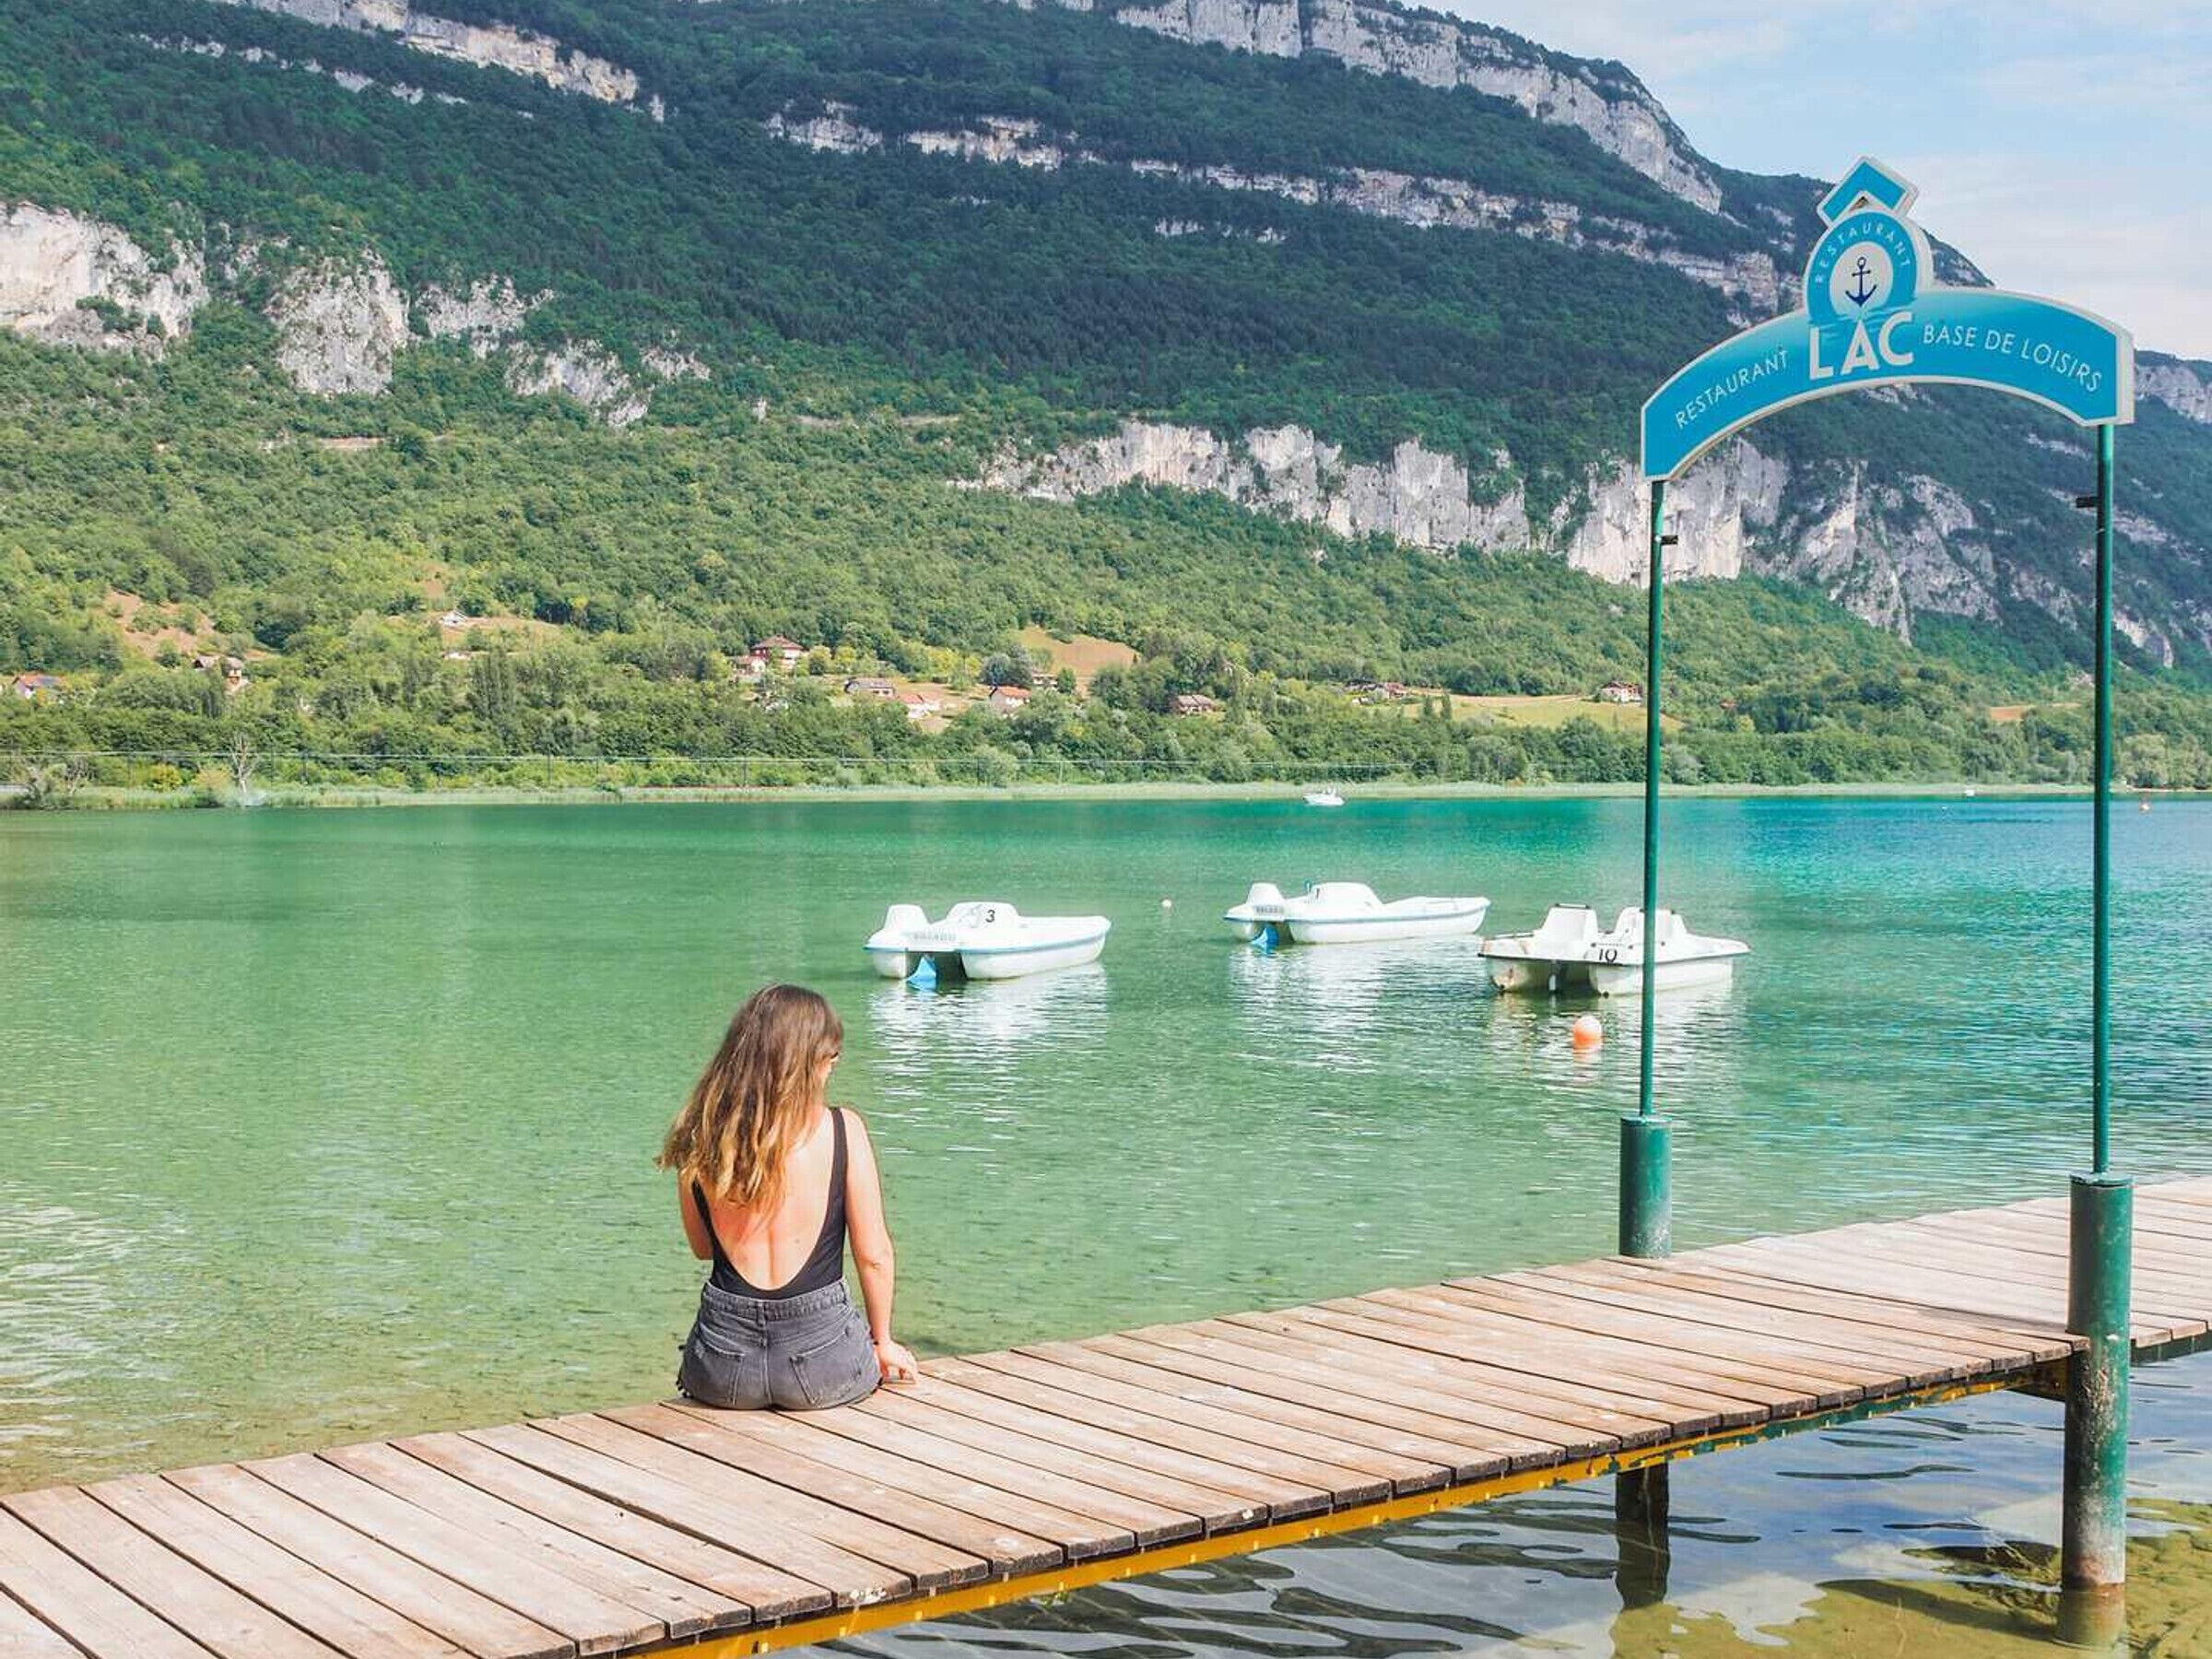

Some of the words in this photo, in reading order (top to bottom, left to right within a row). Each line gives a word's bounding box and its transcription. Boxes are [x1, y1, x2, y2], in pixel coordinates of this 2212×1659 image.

[1814, 221, 1911, 284] RESTAURANT
[1809, 311, 1914, 380] LAC
[1923, 324, 1976, 347] BASE
[1984, 329, 2014, 352] DE
[2021, 336, 2102, 394] LOISIRS
[1676, 350, 1788, 429] RESTAURANT
[985, 909, 996, 924] 3
